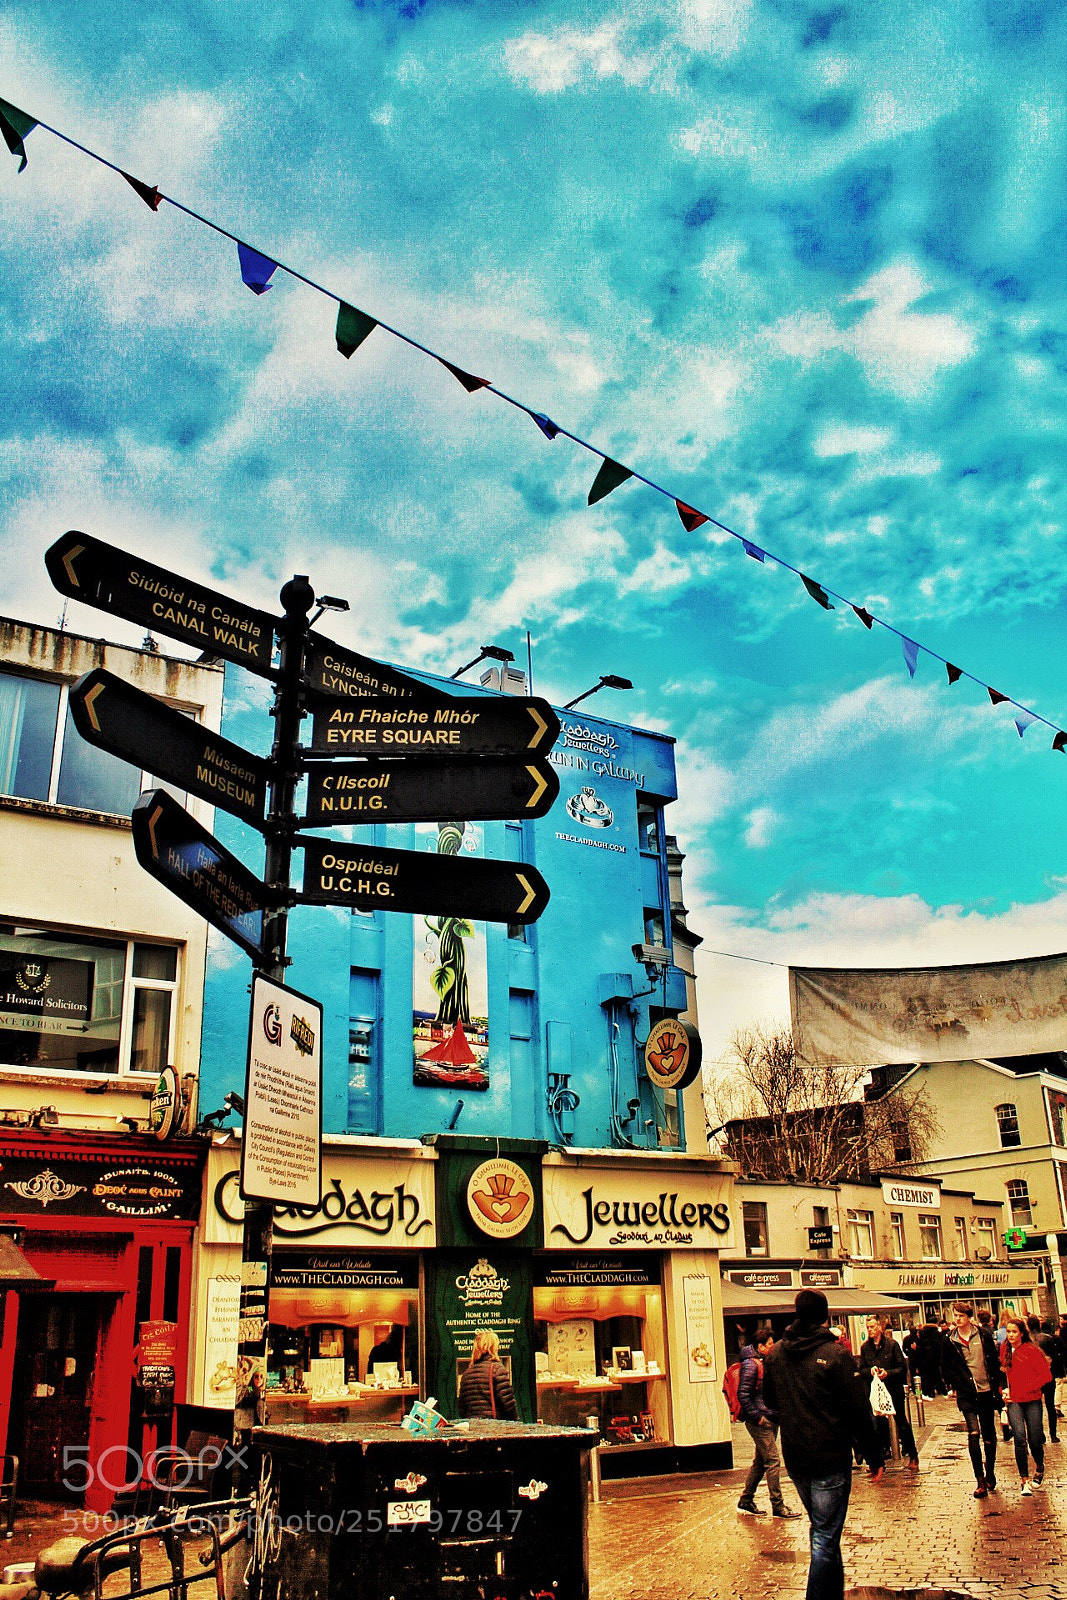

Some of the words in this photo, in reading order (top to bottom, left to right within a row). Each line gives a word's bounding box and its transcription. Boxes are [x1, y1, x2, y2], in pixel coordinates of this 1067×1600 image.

[128, 571, 185, 604] Siúlóid
[187, 599, 206, 614] na
[211, 607, 261, 637] Canála
[152, 602, 209, 636] CANAL
[213, 626, 259, 657] WALK
[323, 656, 379, 688] Caisleán
[382, 683, 397, 696] an
[329, 709, 353, 723] An
[359, 709, 428, 724] Fhaiche
[433, 709, 479, 724] Mhór
[327, 729, 377, 743] EYRE
[382, 730, 461, 745] SQUARE
[560, 718, 620, 750] laddagh
[557, 735, 610, 758] Jewellers
[204, 746, 256, 785] Músaem
[196, 764, 255, 808] MUSEUM
[321, 796, 387, 811] N.U.I.G.
[322, 854, 399, 876] Ospidéal
[167, 849, 190, 881] HALL
[193, 869, 204, 889] OF
[206, 879, 220, 906] THE
[222, 893, 238, 918] RED
[238, 908, 257, 937] EARL
[320, 875, 395, 897] U.C.H.G.
[6, 993, 44, 1006] Howard
[46, 997, 88, 1011] Solicitors
[890, 1187, 934, 1204] CHEMIST
[456, 1276, 511, 1291] Claddagh
[458, 1290, 504, 1301] Jewellers
